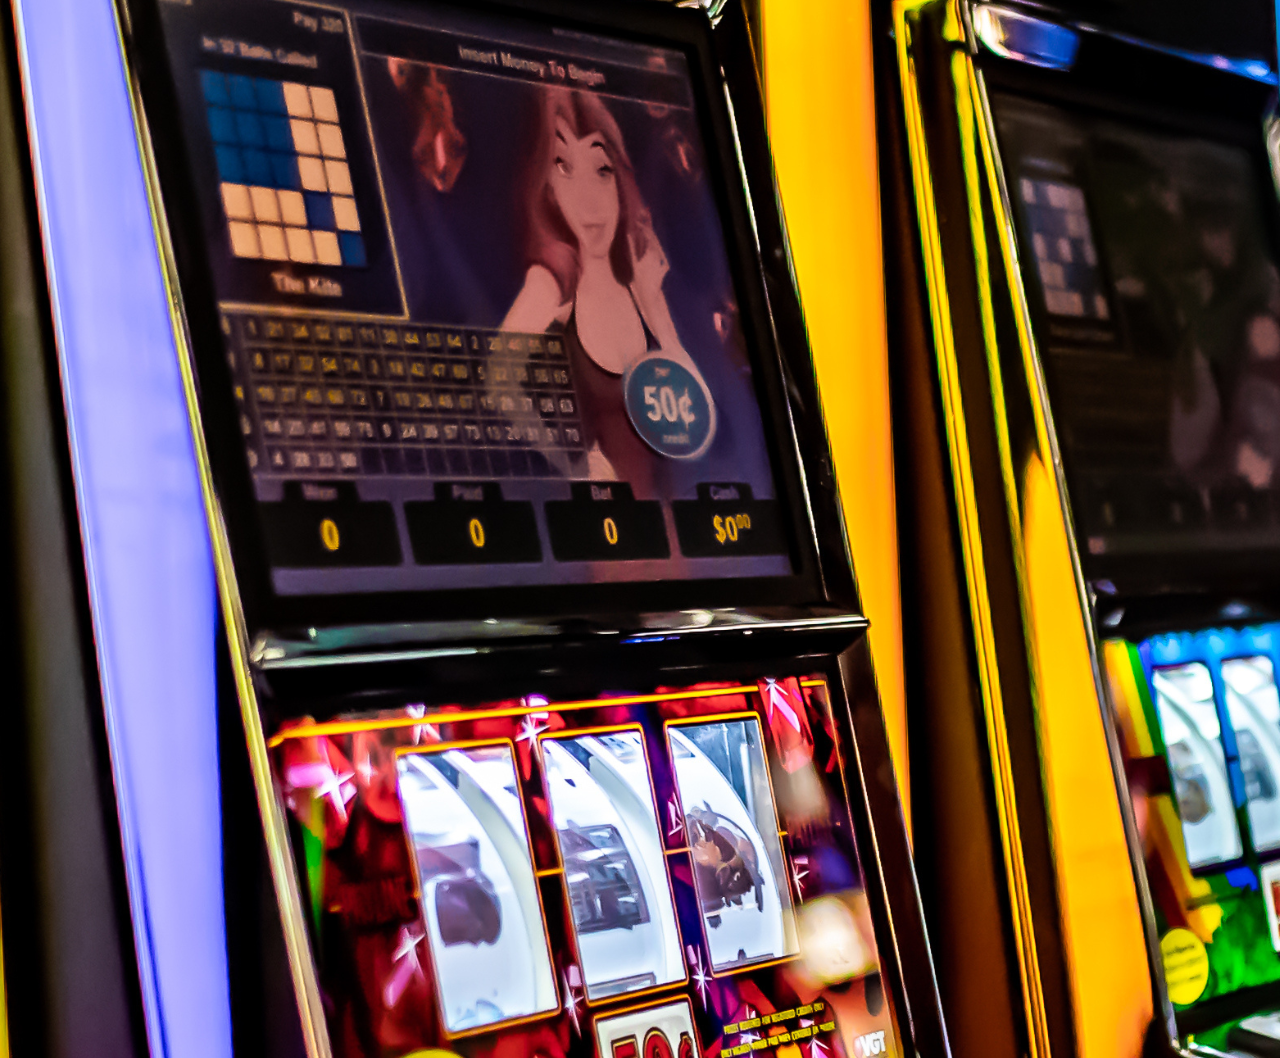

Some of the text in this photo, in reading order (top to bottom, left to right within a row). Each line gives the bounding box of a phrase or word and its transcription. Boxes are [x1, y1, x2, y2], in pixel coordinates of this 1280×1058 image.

[458, 44, 606, 87] Insert Money To Begin
[271, 271, 305, 293] The
[643, 385, 696, 431] 50¢
[591, 484, 612, 500] Bet
[320, 518, 340, 551] 0
[469, 518, 485, 548] 0
[603, 517, 618, 545] 0
[859, 1030, 885, 1057] VGT
